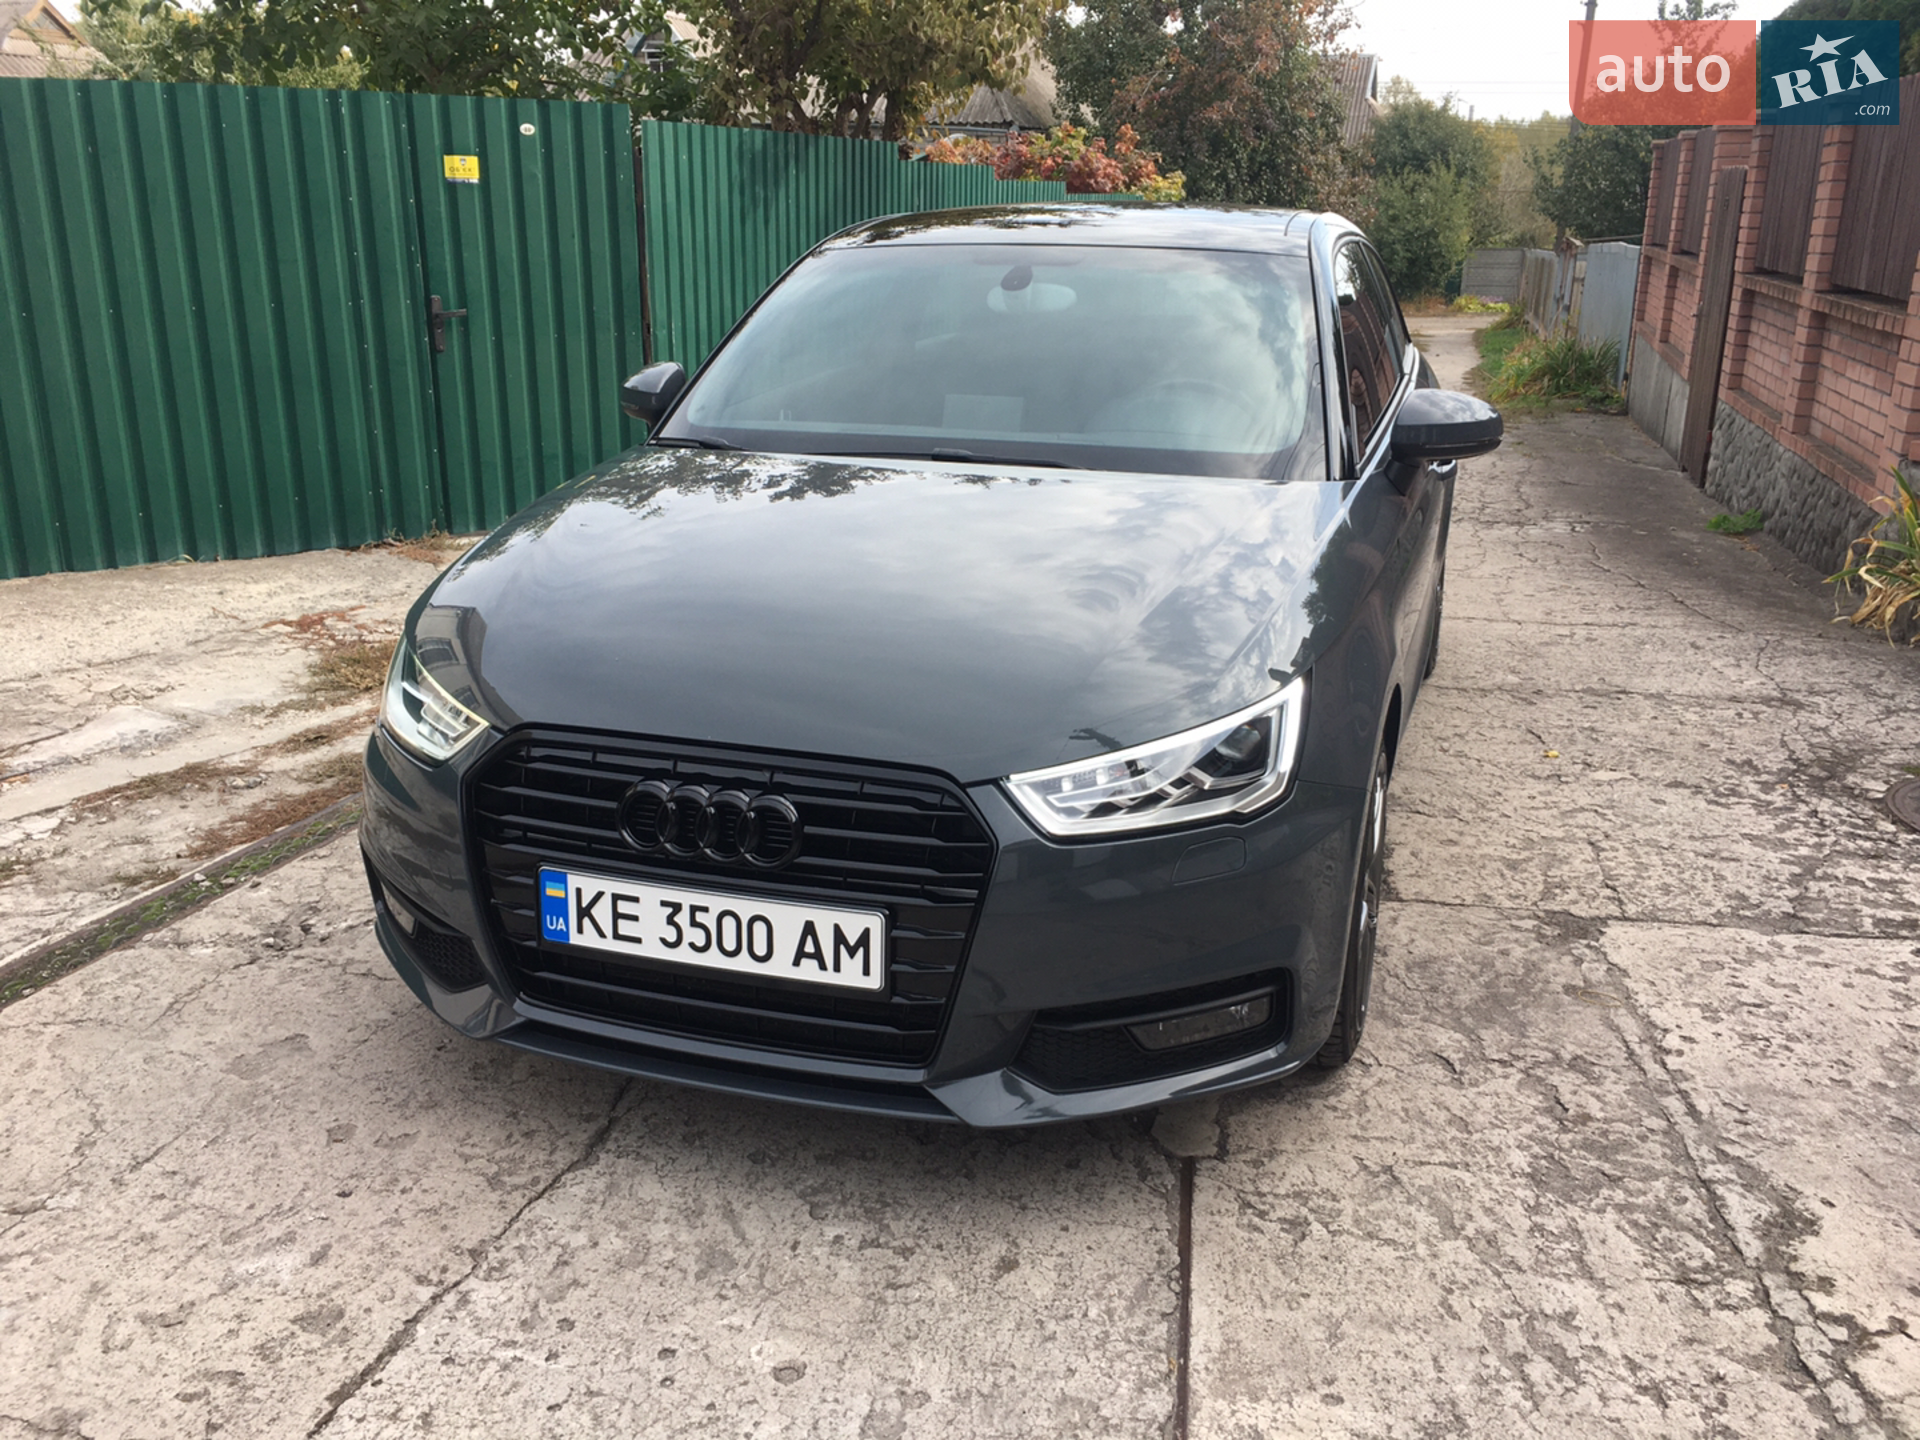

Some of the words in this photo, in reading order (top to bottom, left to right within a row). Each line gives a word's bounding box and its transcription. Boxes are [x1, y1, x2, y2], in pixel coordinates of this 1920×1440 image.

[546, 914, 567, 932] UA
[575, 887, 643, 945] KE
[658, 900, 774, 963] 3500
[791, 919, 871, 977] AM
